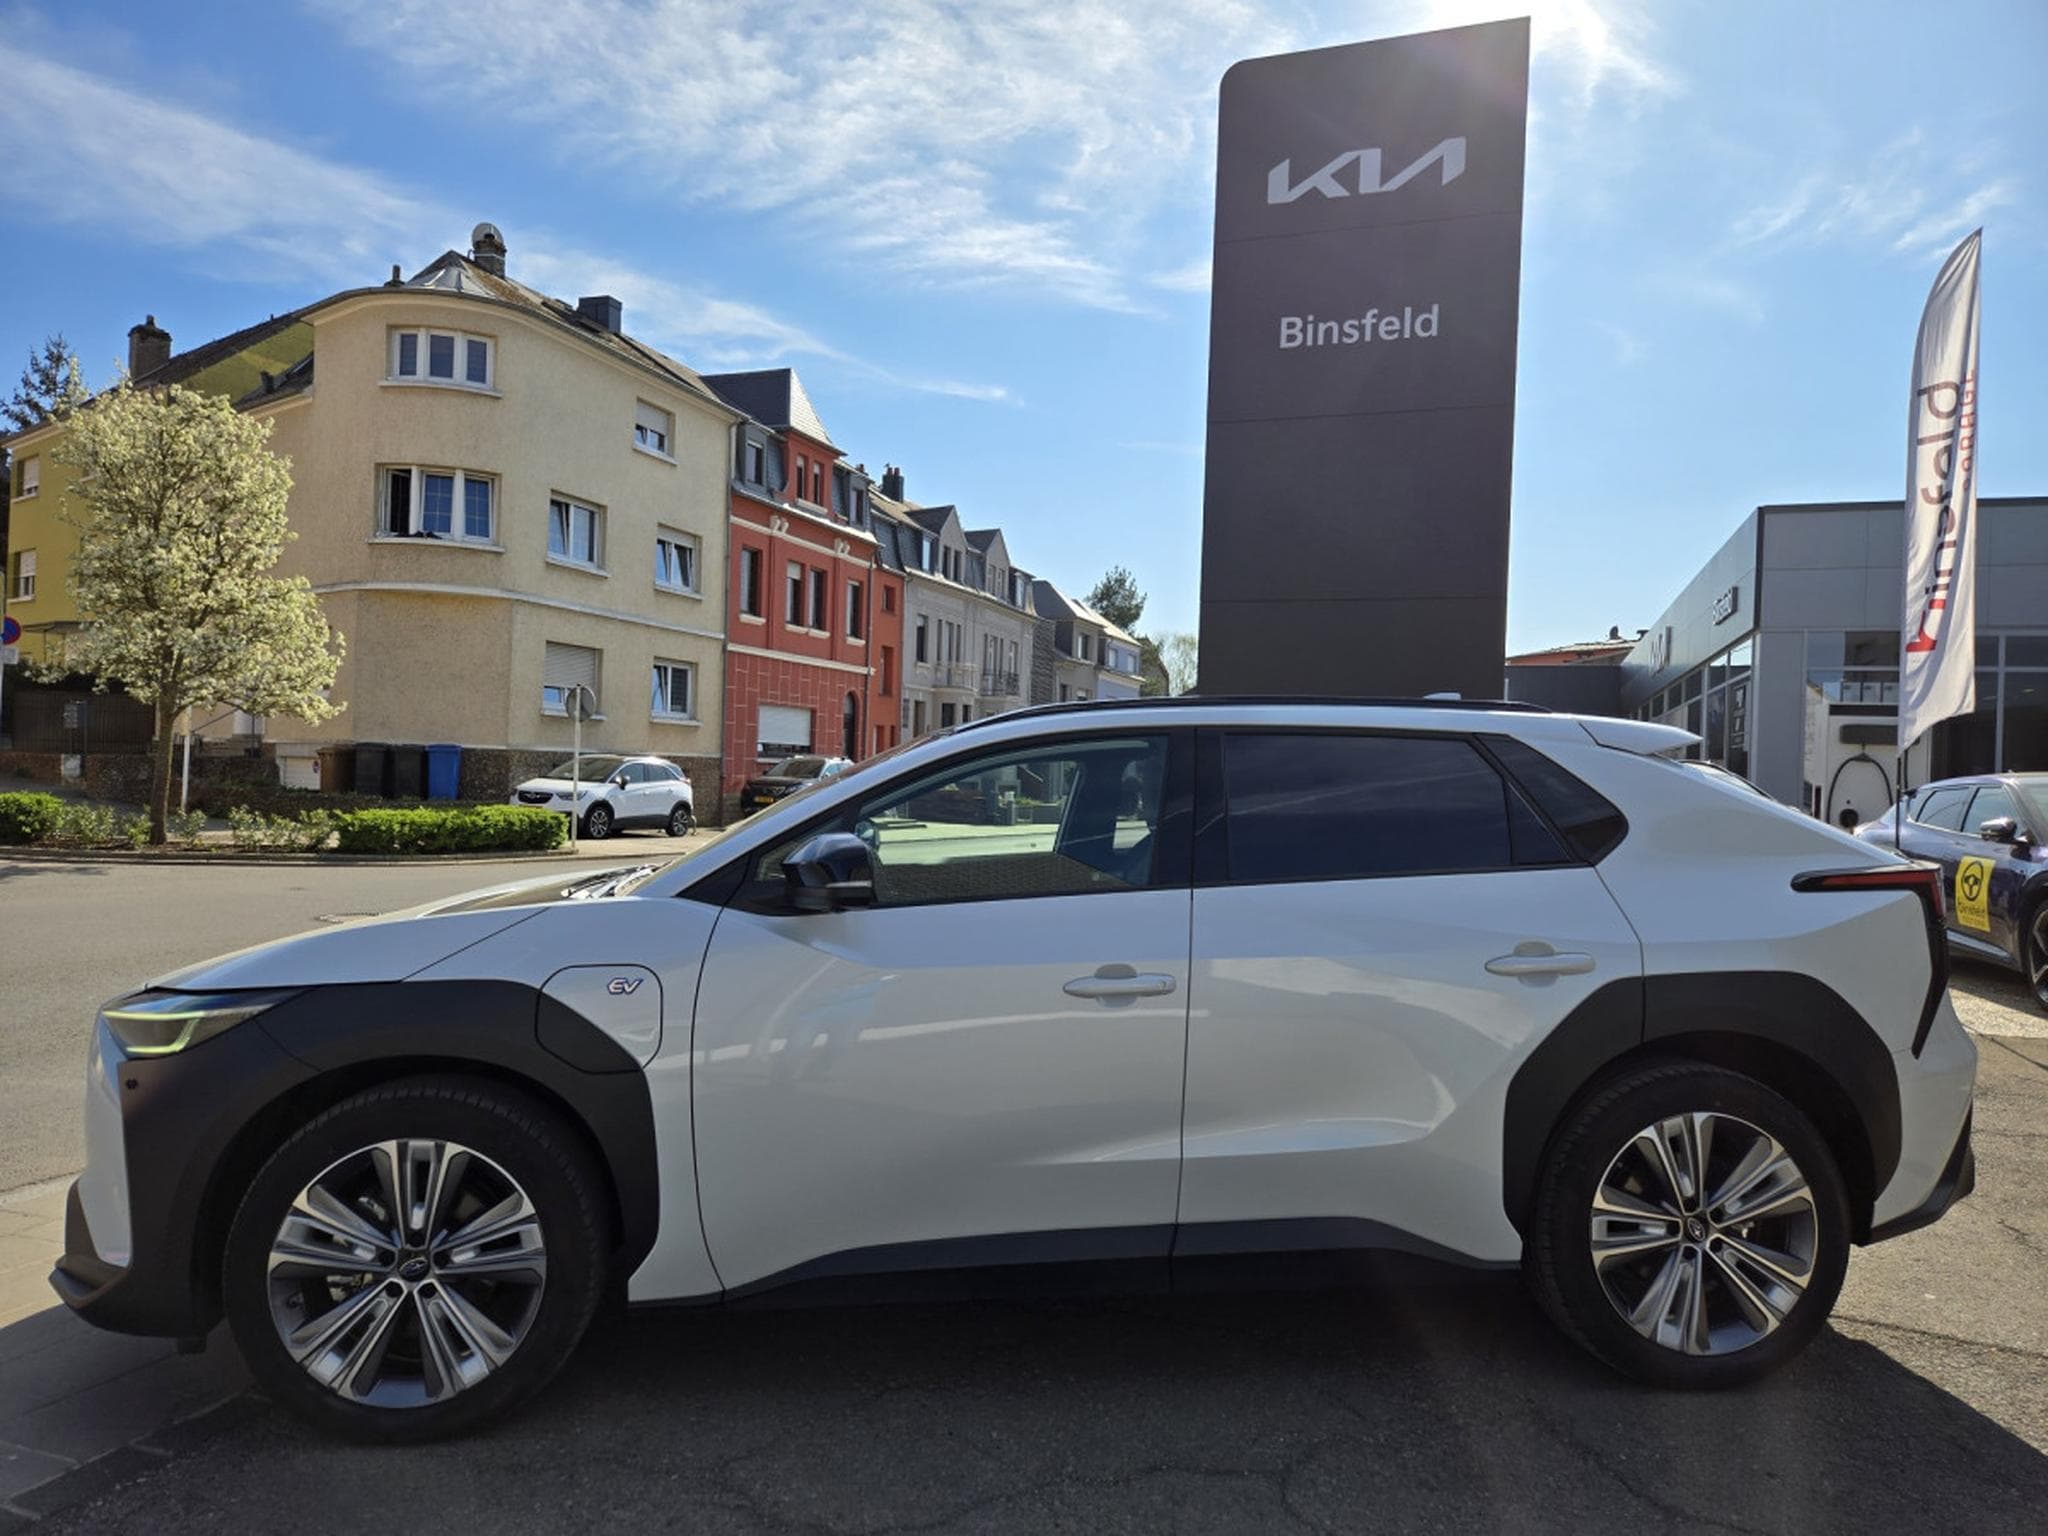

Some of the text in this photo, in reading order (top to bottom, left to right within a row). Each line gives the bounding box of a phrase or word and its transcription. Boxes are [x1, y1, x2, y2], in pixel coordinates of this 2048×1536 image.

[1267, 136, 1467, 205] KIA
[1279, 303, 1439, 349] Binsfeld
[607, 977, 643, 995] EV
